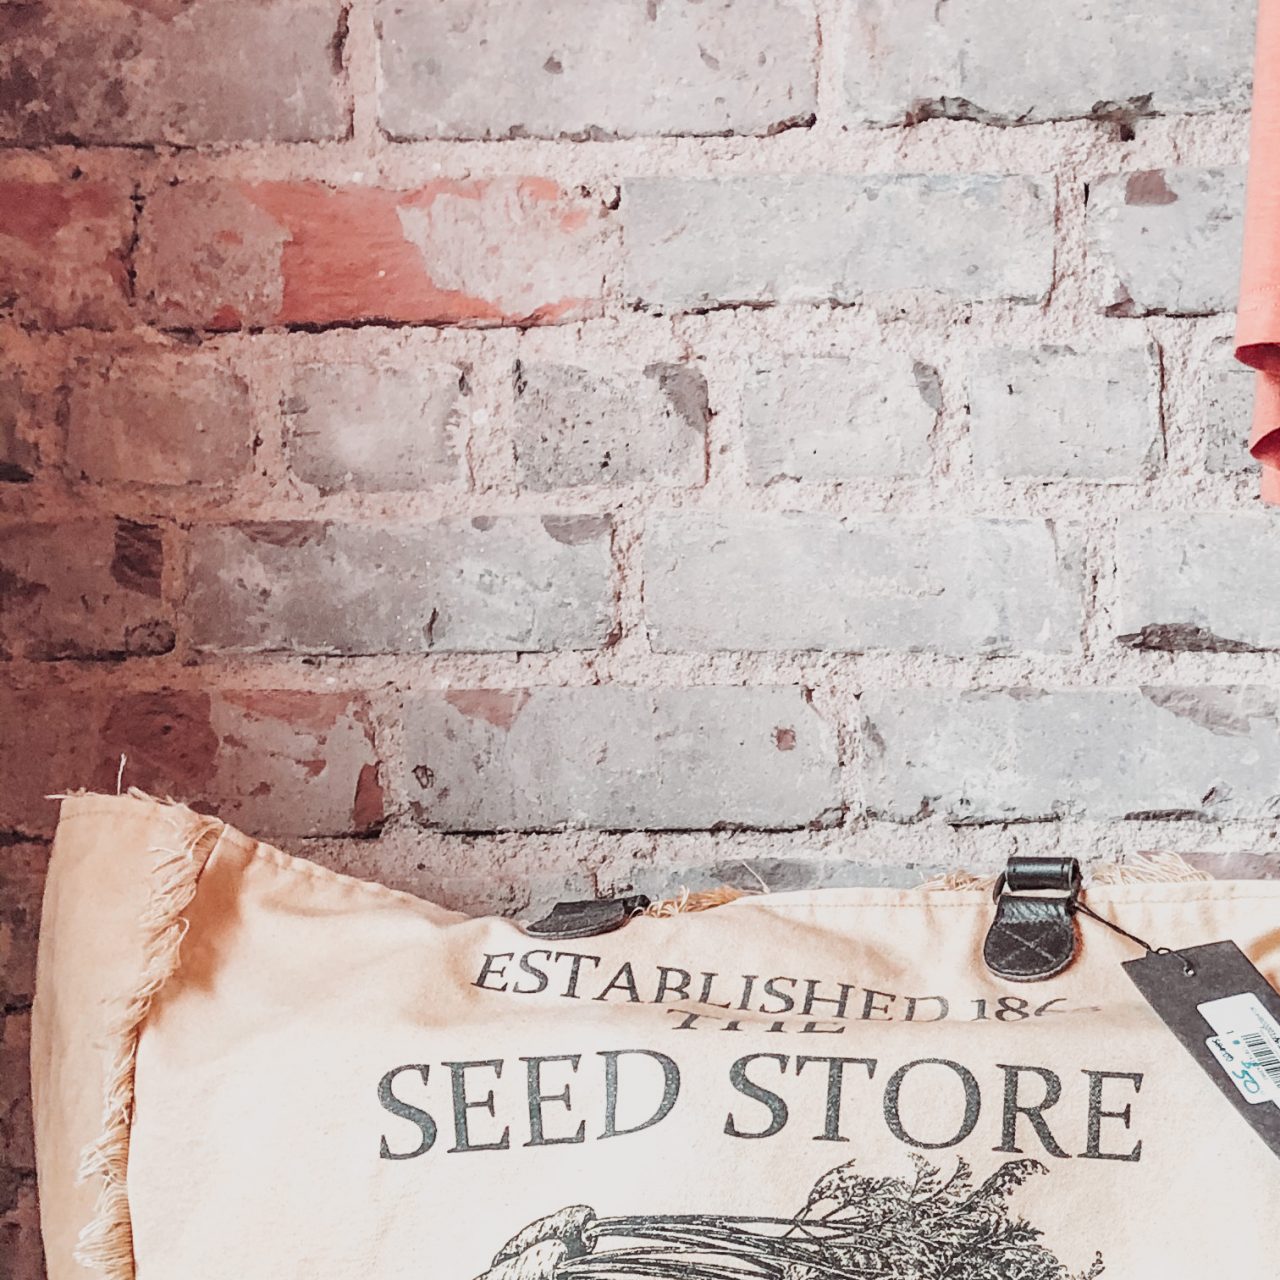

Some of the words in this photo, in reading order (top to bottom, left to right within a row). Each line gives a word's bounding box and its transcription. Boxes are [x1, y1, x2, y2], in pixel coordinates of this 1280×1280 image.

[470, 949, 950, 1023] ESTABLISHED
[377, 1048, 681, 1161] SEED
[723, 1052, 1145, 1163] STORE
